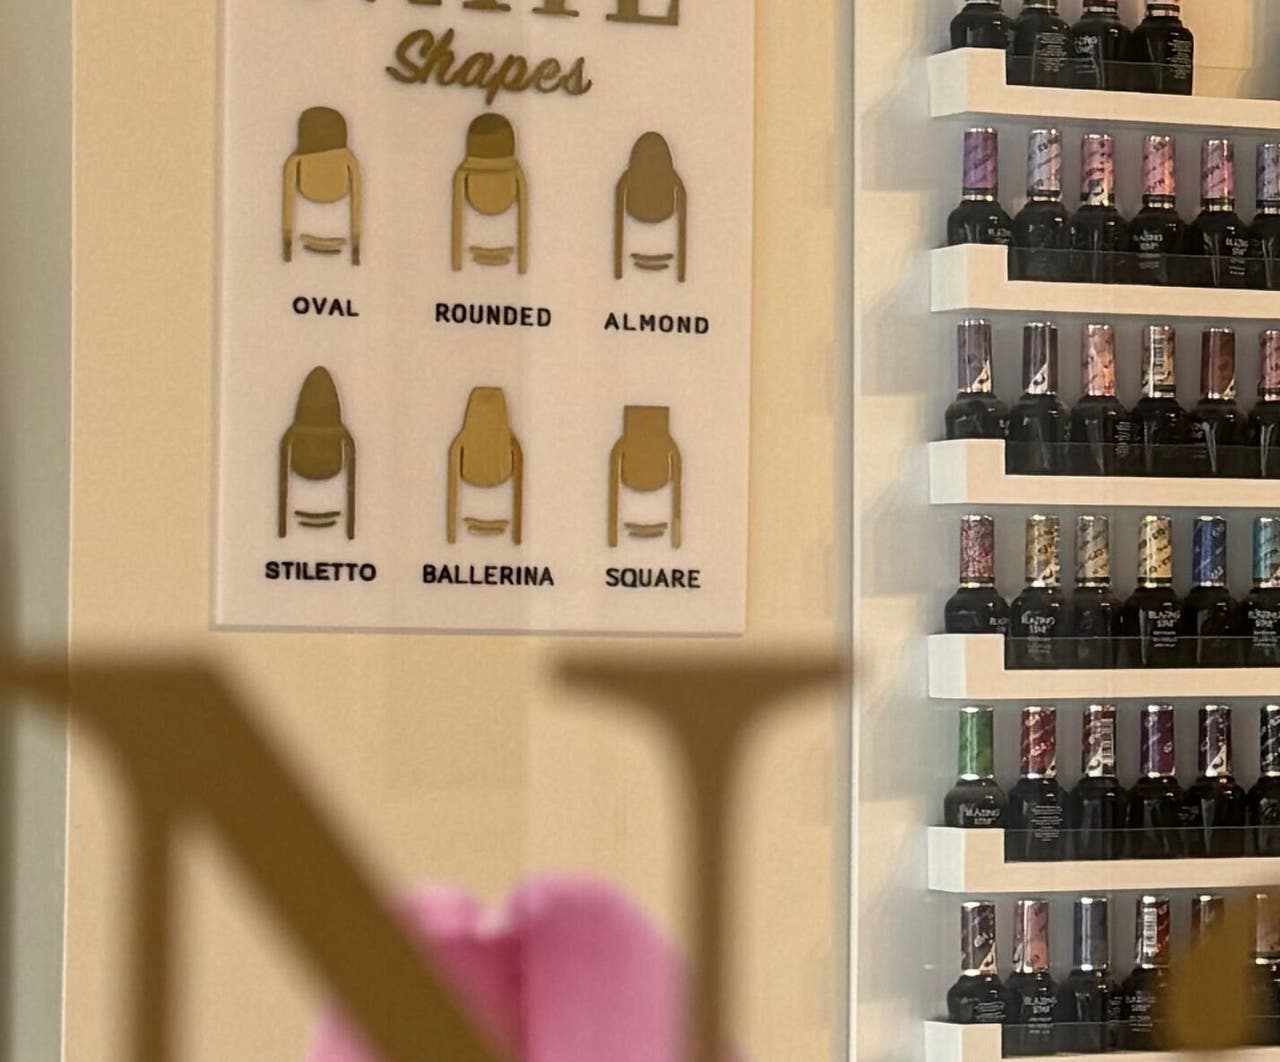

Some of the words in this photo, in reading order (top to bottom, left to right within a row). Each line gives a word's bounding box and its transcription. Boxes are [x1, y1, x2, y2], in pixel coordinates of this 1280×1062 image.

[386, 28, 592, 105] Shapes
[292, 296, 359, 318] OVAL
[434, 302, 552, 328] ROUNDED
[603, 312, 710, 335] ALMOND
[264, 560, 377, 583] STILETTO
[422, 564, 555, 588] BALLERINA
[605, 568, 701, 590] SQUARE
